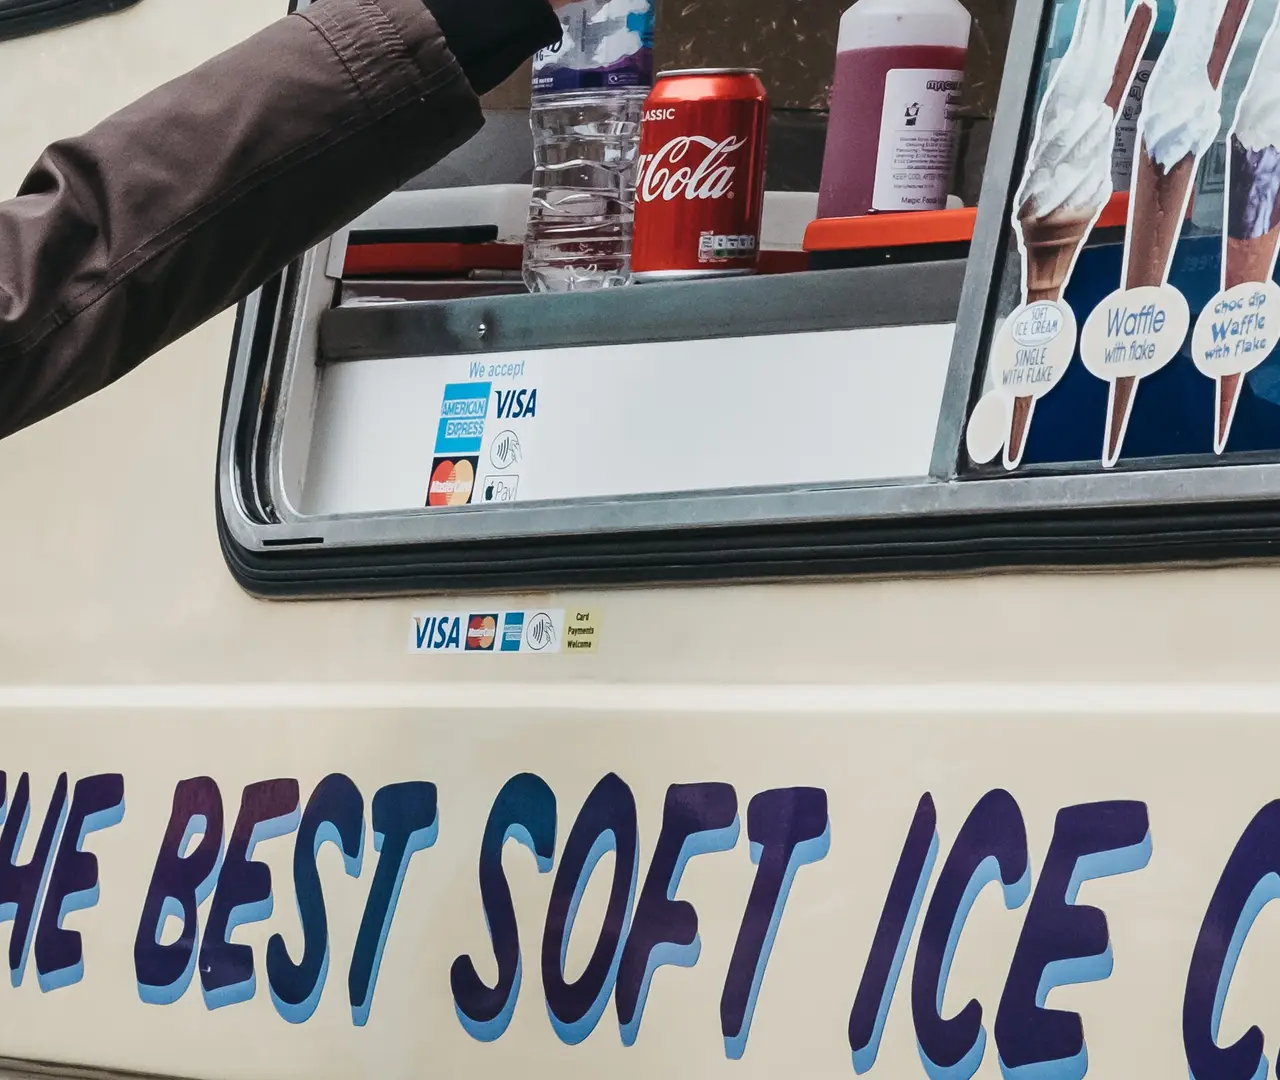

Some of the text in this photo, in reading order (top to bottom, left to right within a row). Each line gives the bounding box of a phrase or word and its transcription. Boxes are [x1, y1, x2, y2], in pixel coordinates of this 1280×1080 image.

[641, 108, 676, 122] LASSIC
[1249, 292, 1266, 311] dip
[1015, 319, 1058, 338] ICE CREAM
[1107, 304, 1166, 339] Waffle
[1211, 314, 1266, 344] Waffle
[1014, 347, 1047, 367] SINGLE
[1104, 341, 1156, 364] with flake
[1204, 343, 1230, 361] with
[469, 360, 525, 380] We accept
[1002, 366, 1053, 385] WITH FLAKE
[441, 399, 484, 417] AMERICAN
[494, 388, 537, 419] VISA
[446, 420, 484, 438] EXPRESS
[495, 480, 515, 502] Pay
[575, 612, 590, 622] Card
[412, 616, 460, 649] VISA
[567, 625, 595, 637] Payments
[567, 640, 592, 649] Welcome
[132, 772, 440, 1027] BEST
[450, 770, 830, 1061] SOFT
[847, 786, 1153, 1080] ICE
